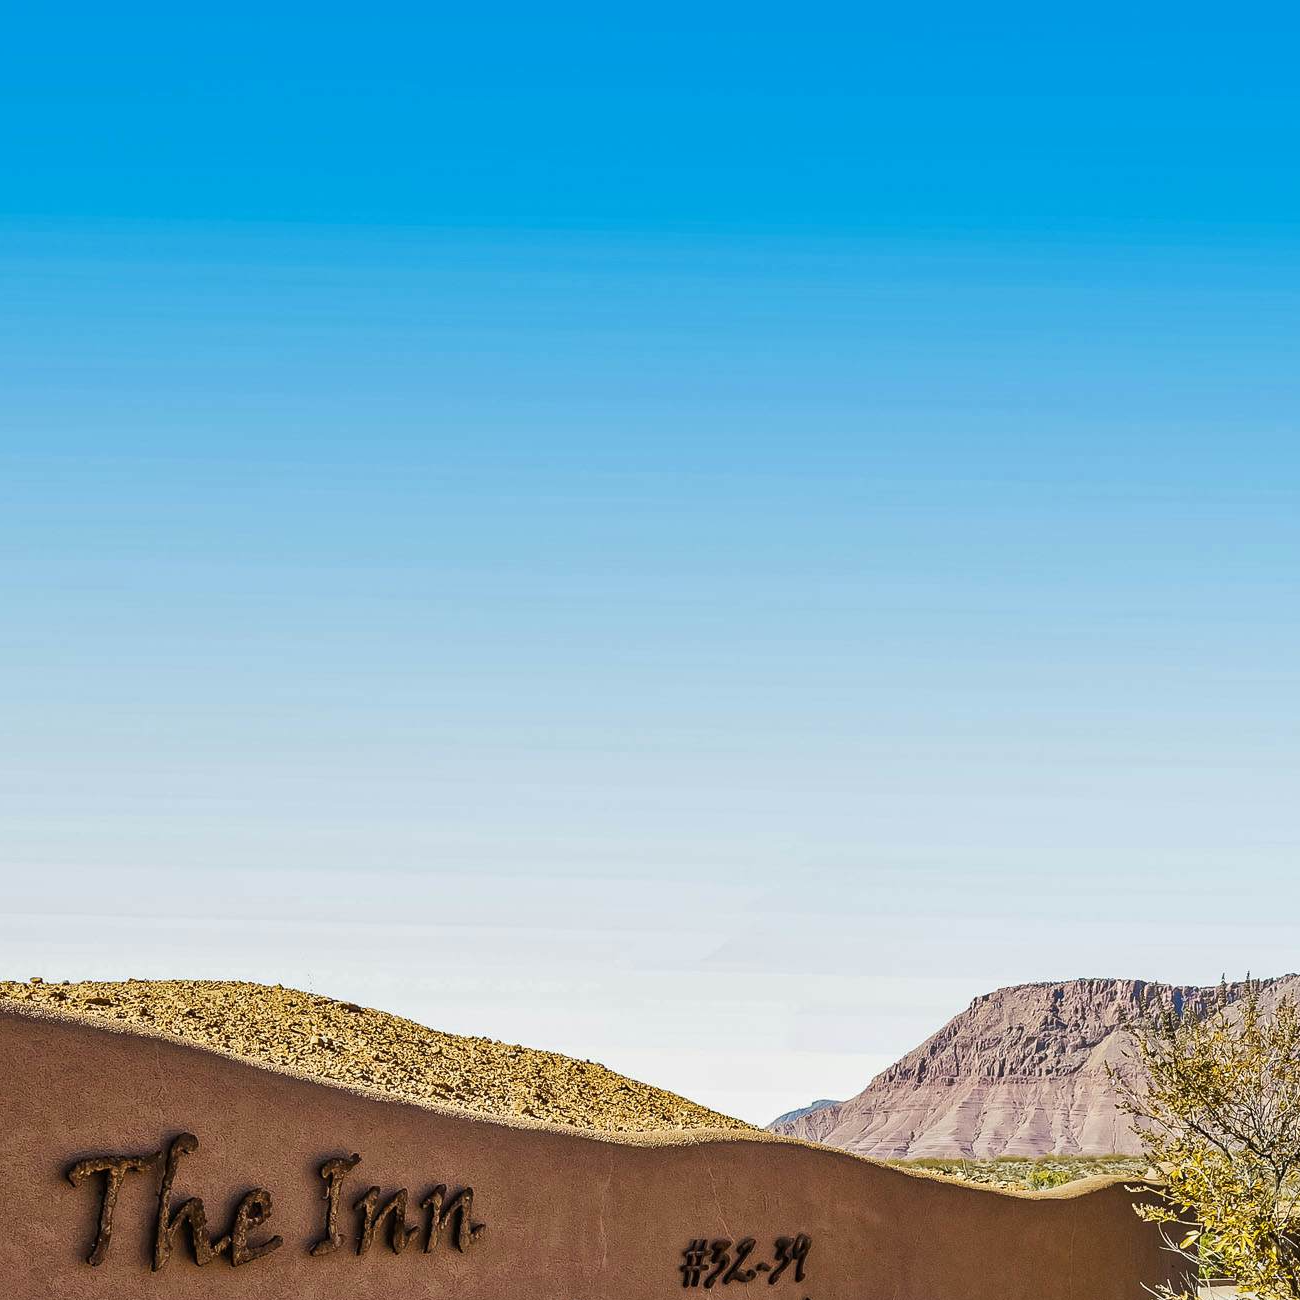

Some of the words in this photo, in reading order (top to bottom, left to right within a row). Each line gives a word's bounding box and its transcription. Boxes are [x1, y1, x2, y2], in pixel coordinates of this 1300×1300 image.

[67, 1132, 284, 1272] The
[308, 1153, 486, 1256] Inn
[680, 1233, 813, 1289] #32-39
